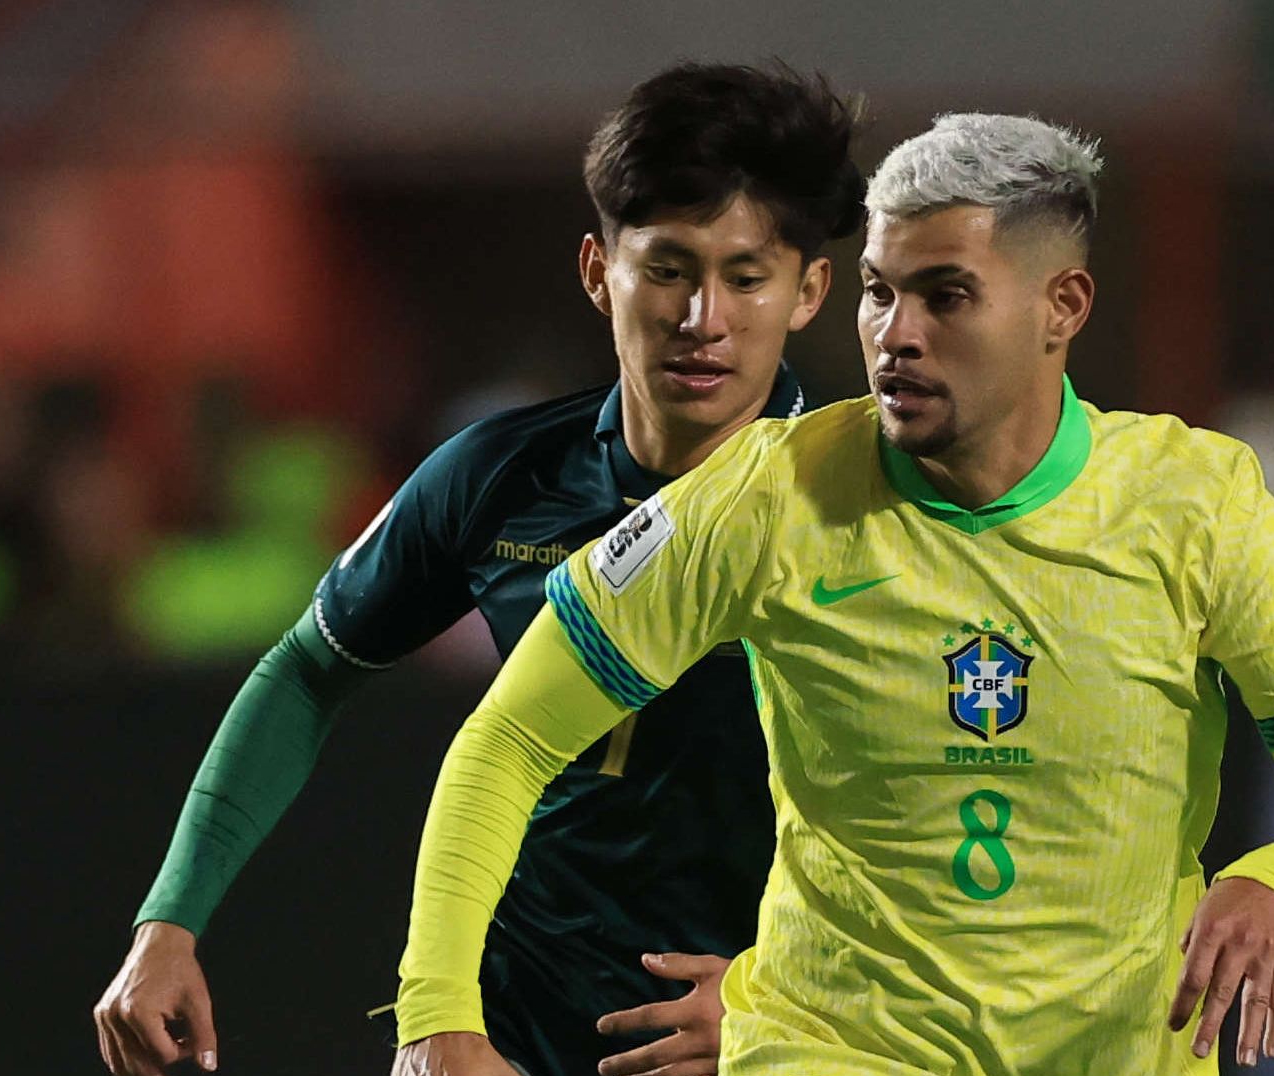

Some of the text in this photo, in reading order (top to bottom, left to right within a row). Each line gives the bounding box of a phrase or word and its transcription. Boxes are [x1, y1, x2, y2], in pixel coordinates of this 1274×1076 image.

[495, 539, 570, 565] marath
[972, 678, 1005, 691] CBF
[944, 746, 1035, 764] BRASIL
[952, 788, 1016, 901] 8
